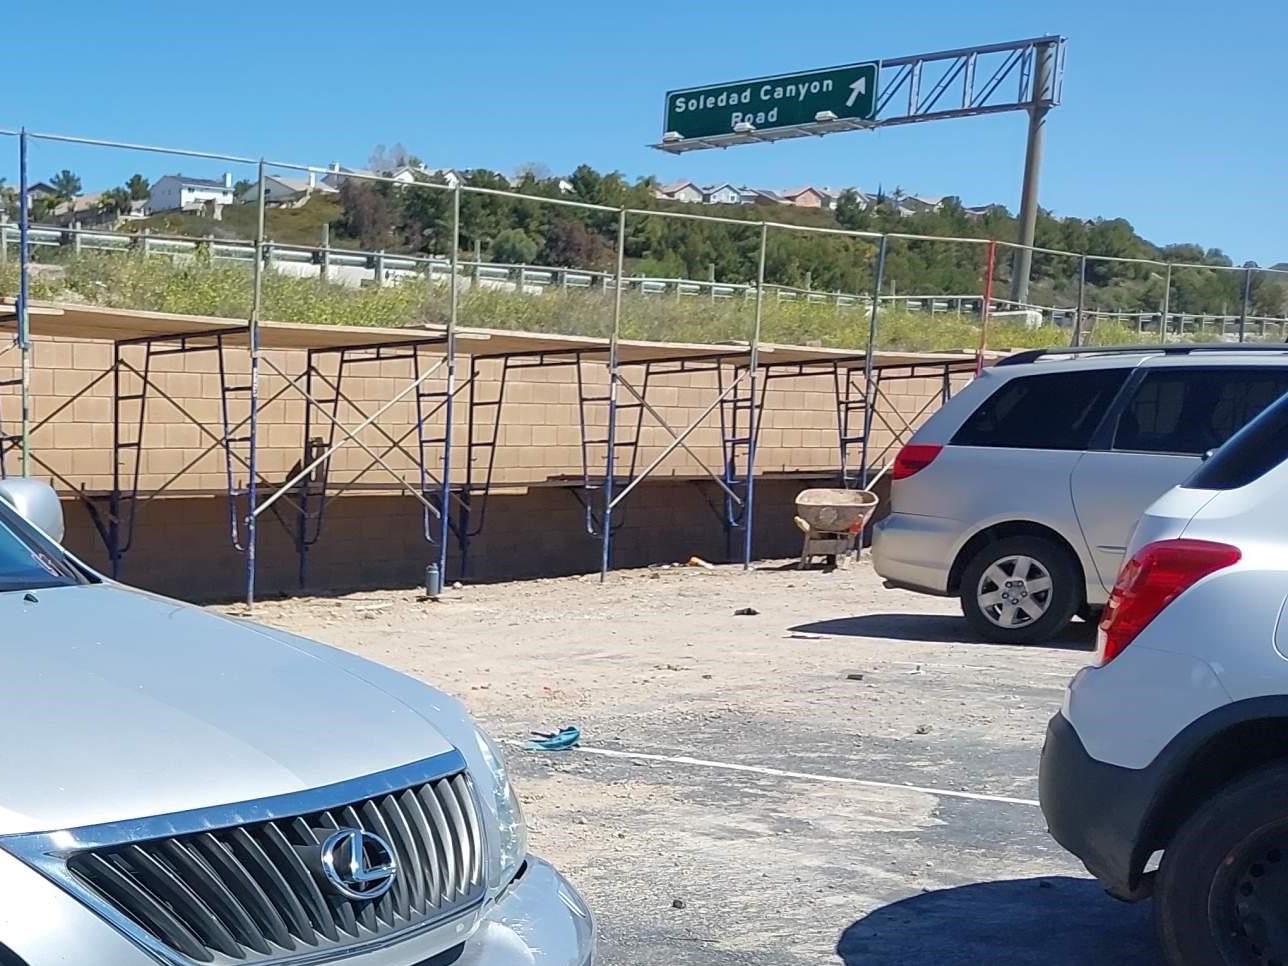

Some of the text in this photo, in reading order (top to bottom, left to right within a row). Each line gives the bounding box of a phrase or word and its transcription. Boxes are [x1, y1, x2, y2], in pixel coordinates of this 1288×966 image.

[674, 79, 833, 113] Soledad Canyon
[730, 106, 778, 128] Road
